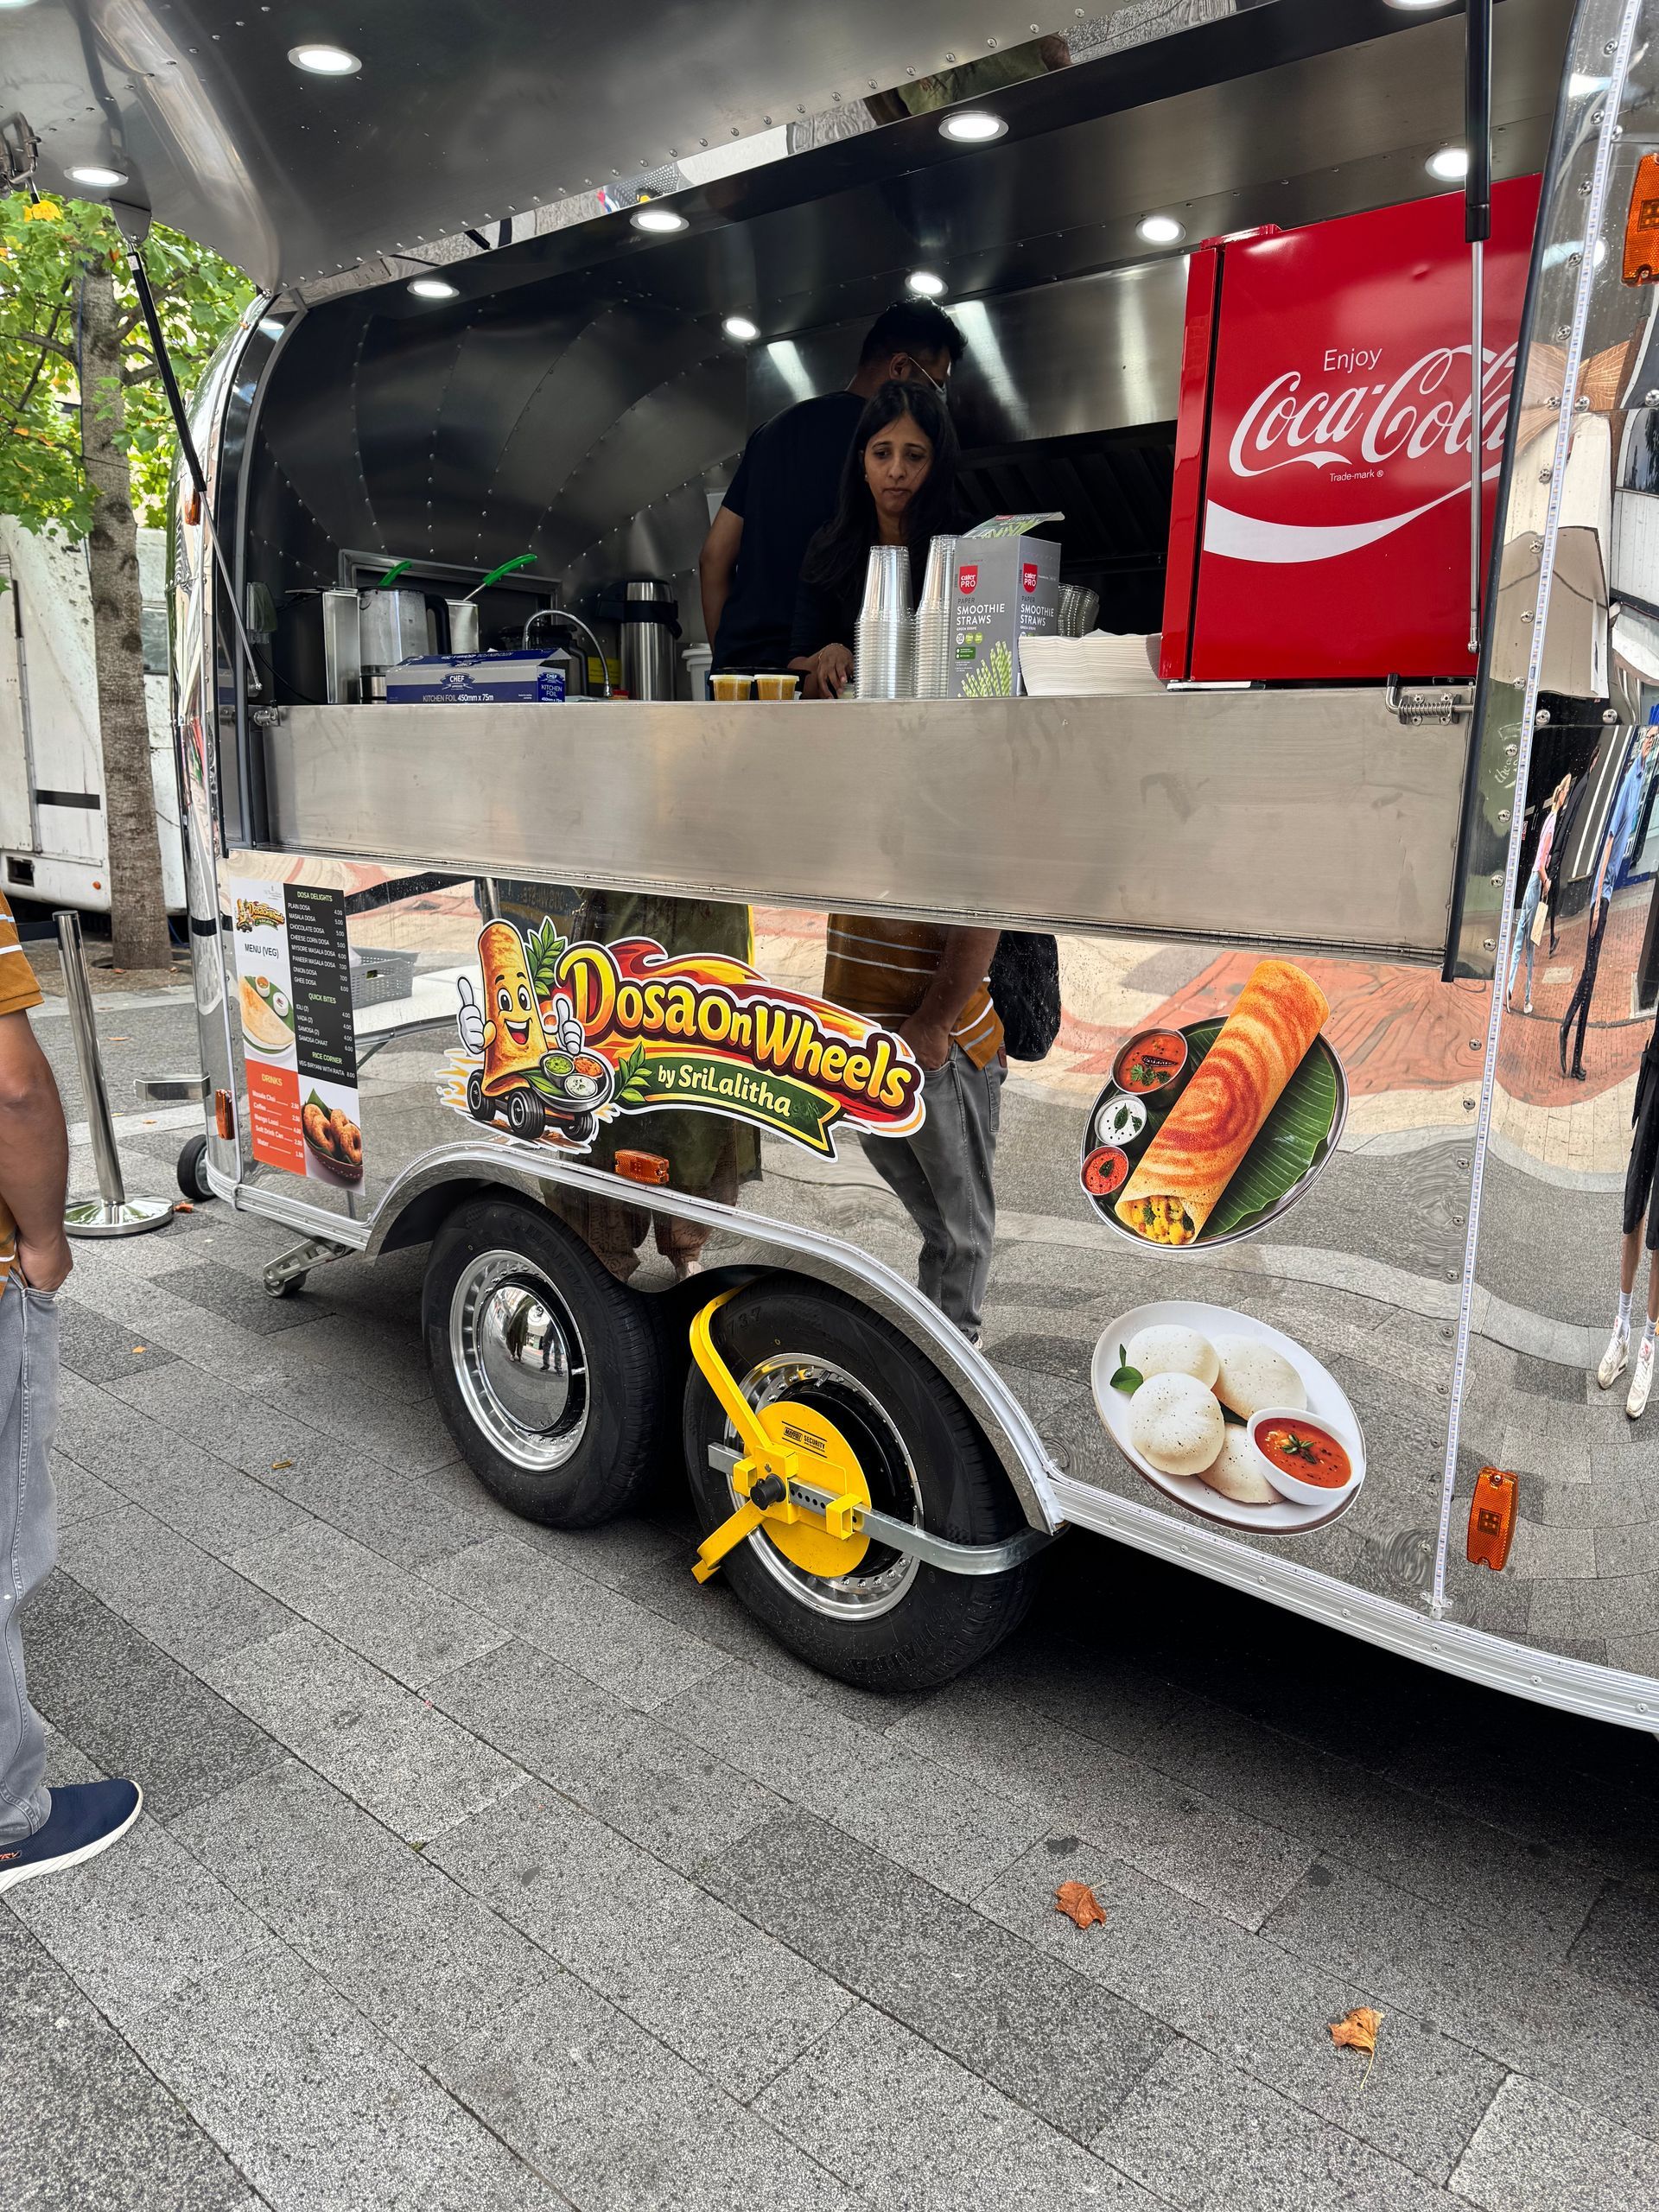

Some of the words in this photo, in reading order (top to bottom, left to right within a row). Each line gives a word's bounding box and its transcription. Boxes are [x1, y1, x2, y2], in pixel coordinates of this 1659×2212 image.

[1324, 348, 1382, 373] Enjoy
[1230, 340, 1518, 477] Coca-Cola
[1330, 470, 1375, 482] Trade-mark
[960, 580, 976, 588] PRO
[1023, 579, 1037, 588] PRO
[957, 603, 1006, 615] SMOOTHIE
[1020, 603, 1055, 618] SMOOTHIE
[956, 614, 992, 626] STRAWS
[1020, 614, 1046, 627] STRAWS
[449, 675, 465, 683] CHEF
[458, 693, 478, 702] 450mm
[482, 693, 494, 702] 75m
[310, 893, 334, 902] DELIGHTS
[304, 914, 316, 923] DOSA
[289, 923, 313, 933] CHOCOLATE
[245, 944, 262, 954] MENU
[262, 946, 279, 959] (VEG)
[308, 947, 324, 956] MASALA
[308, 957, 324, 966] MASALA
[306, 968, 318, 976] DOSA
[294, 976, 306, 985] GHEE
[306, 978, 317, 987] DOSA
[308, 993, 323, 1001] QUICK
[323, 995, 337, 1004] BITES
[297, 1025, 315, 1034] SAMOSA
[298, 1035, 315, 1044] SAMOSA
[312, 1051, 323, 1060] RICE
[323, 1054, 343, 1065] CORNER
[261, 1073, 283, 1087] DRINKS
[658, 1065, 674, 1090] by
[678, 1068, 792, 1118] SriLalitha
[804, 1434, 826, 1450] SECURITY
